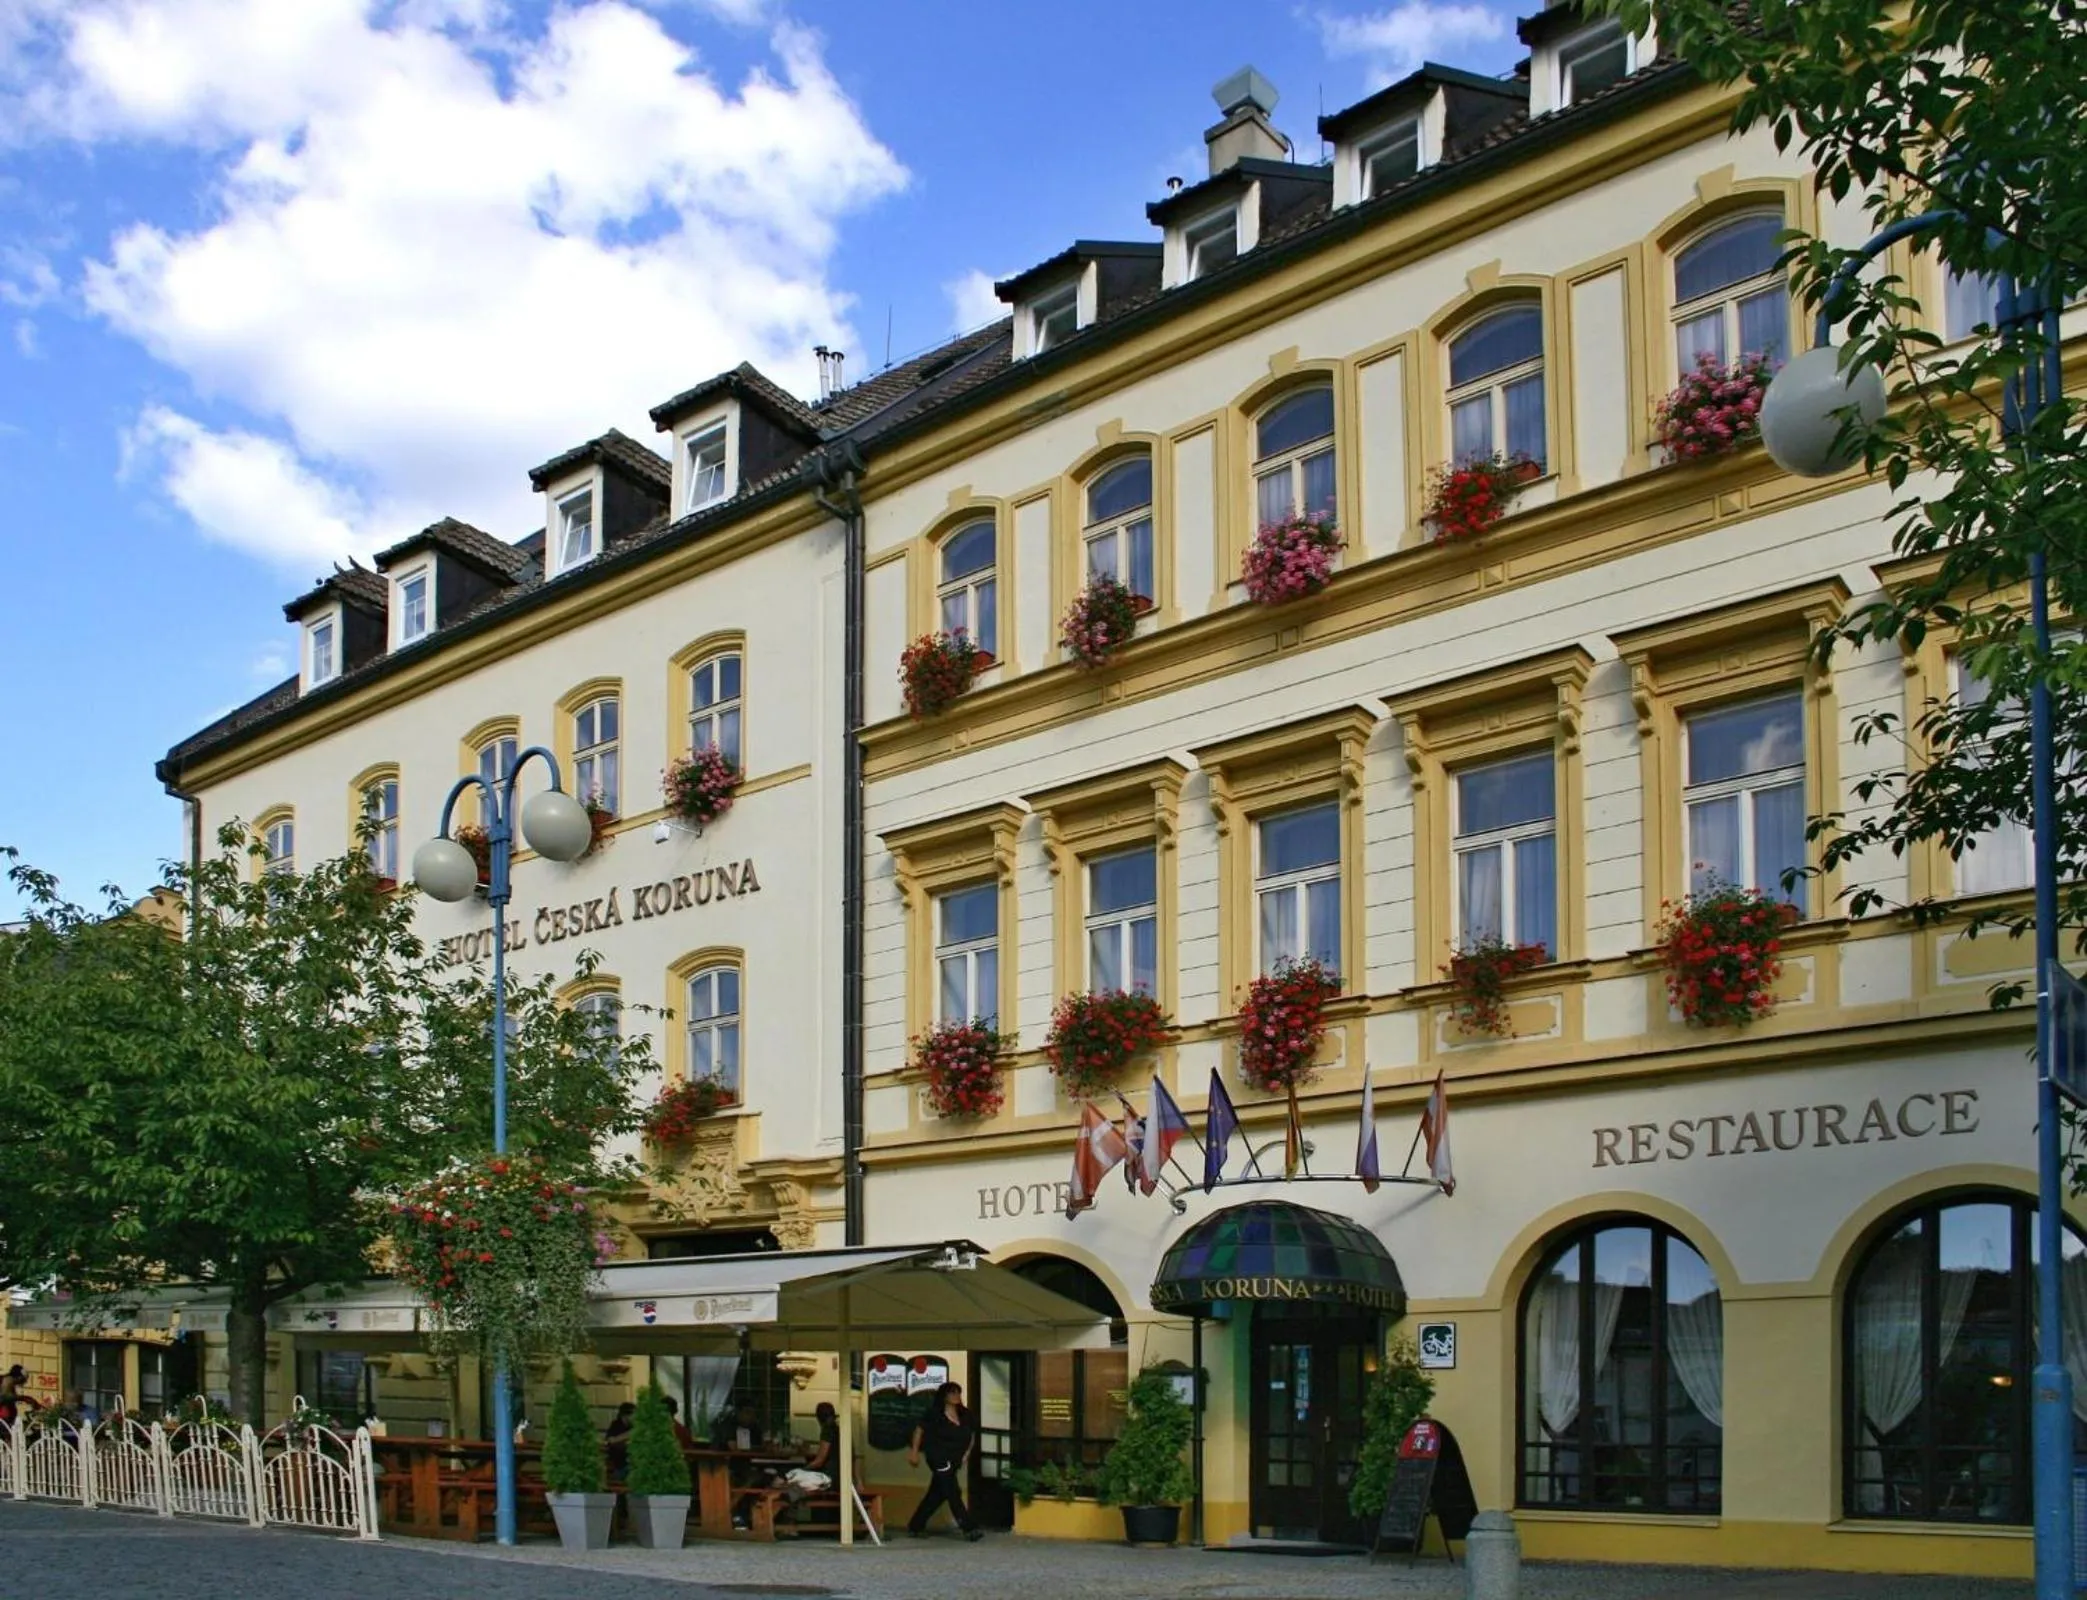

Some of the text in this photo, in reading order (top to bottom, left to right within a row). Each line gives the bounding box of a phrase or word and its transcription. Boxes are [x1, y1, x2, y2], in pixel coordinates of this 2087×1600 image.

[534, 886, 623, 946] ČESKÁ
[632, 858, 762, 921] KORUNA
[1592, 1089, 1980, 1168] RESTAURACE
[977, 1181, 1098, 1220] HOTE
[1201, 1277, 1312, 1299] KORUNA
